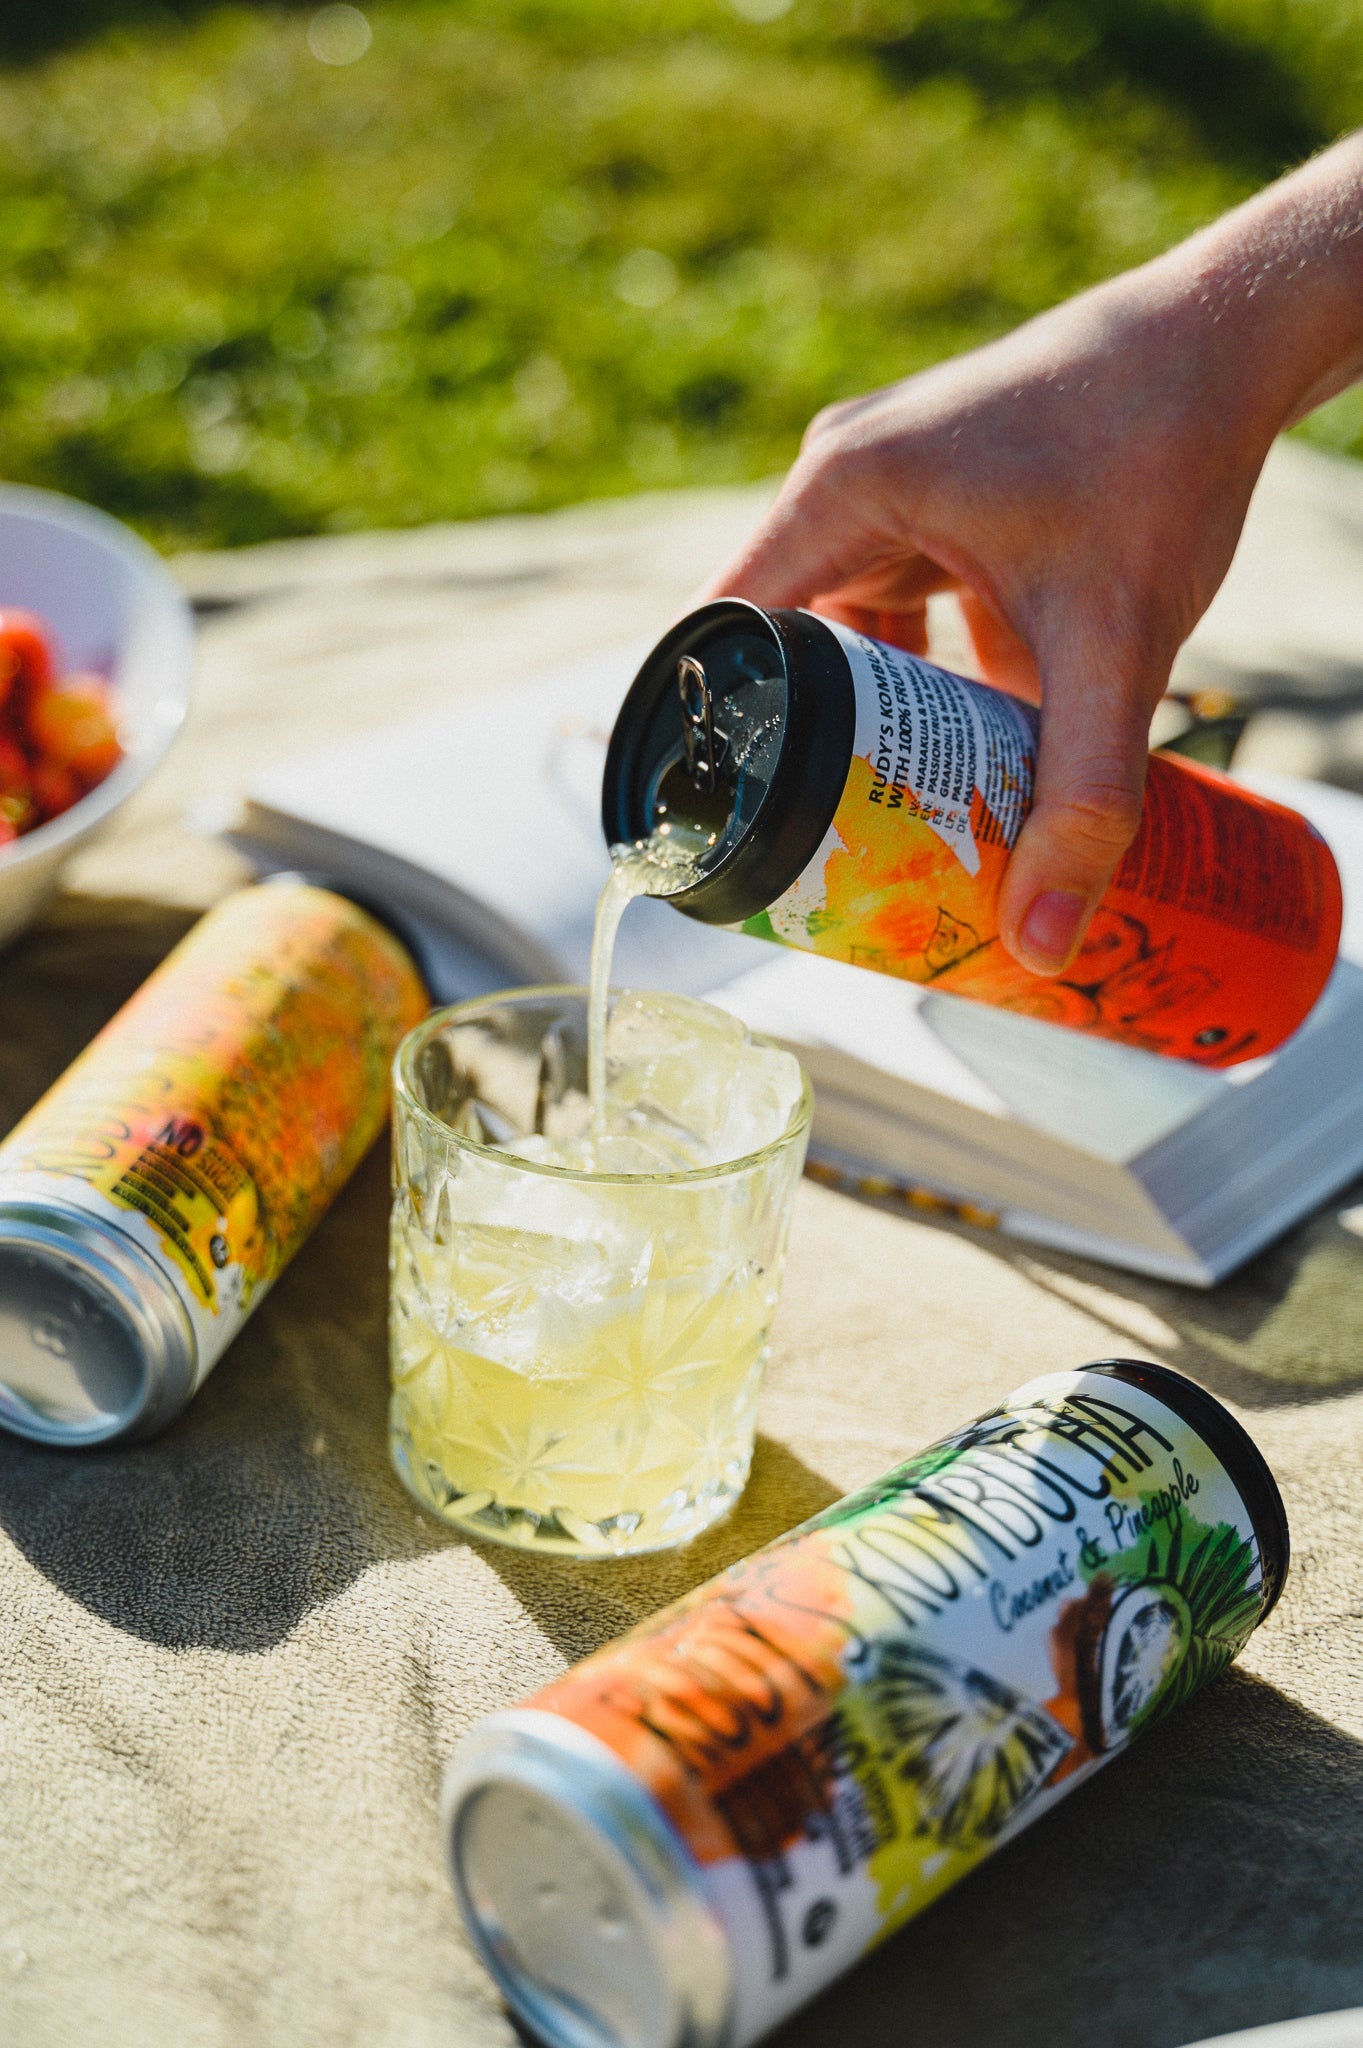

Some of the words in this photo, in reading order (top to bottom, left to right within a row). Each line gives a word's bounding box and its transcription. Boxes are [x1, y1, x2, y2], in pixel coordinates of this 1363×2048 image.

[889, 662, 913, 705] FRUIT
[898, 706, 913, 756] 100%
[921, 707, 930, 719] &
[928, 705, 942, 738] FRUIT
[869, 724, 894, 805] RUDY'S
[916, 718, 930, 790] MARAKUJA
[927, 739, 942, 794] PASSION
[932, 805, 946, 826] EE:
[939, 725, 955, 798] GRANADILL
[944, 811, 957, 830] LT:
[951, 727, 967, 803] PASIFLOROS
[887, 758, 911, 809] WITH
[920, 799, 935, 822] EN:
[956, 811, 968, 834] DE:
[840, 1393, 1175, 1628] KOMBUCHA
[1076, 1526, 1108, 1569] &
[1104, 1457, 1200, 1551] Pineapple
